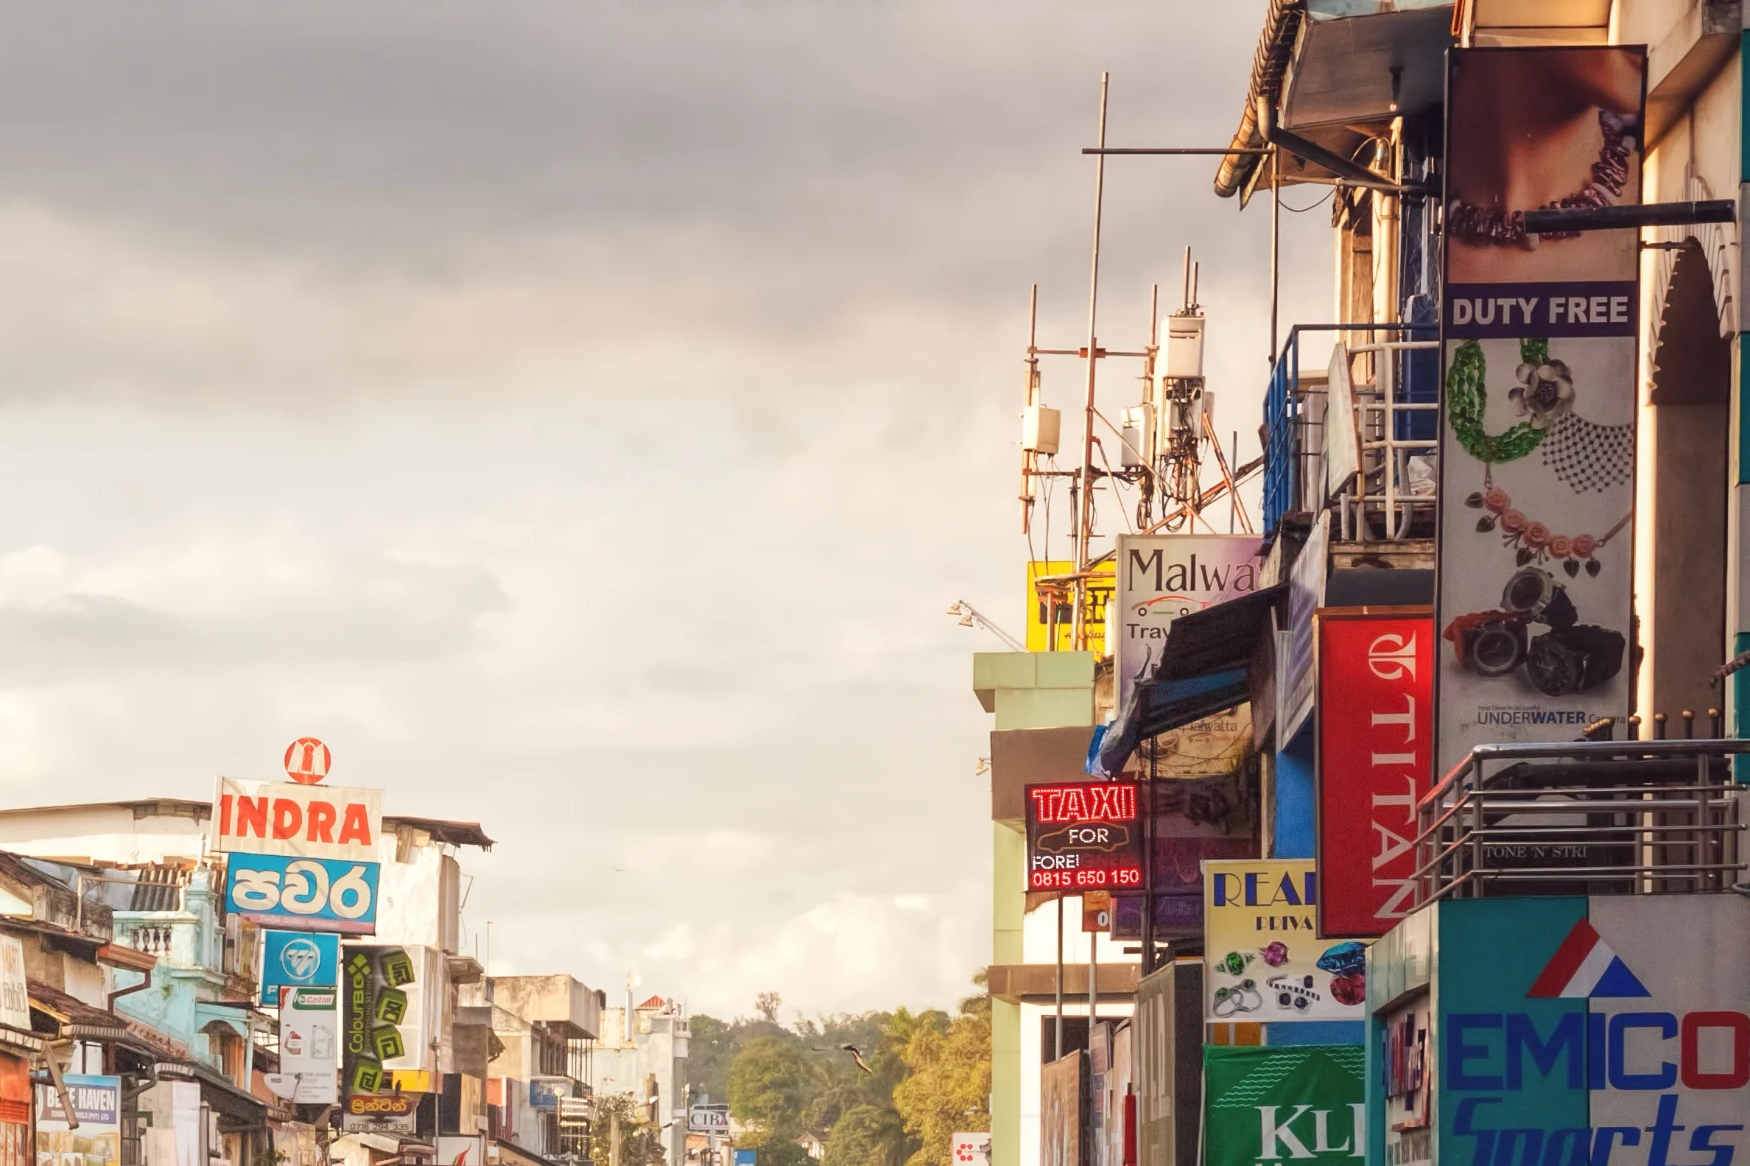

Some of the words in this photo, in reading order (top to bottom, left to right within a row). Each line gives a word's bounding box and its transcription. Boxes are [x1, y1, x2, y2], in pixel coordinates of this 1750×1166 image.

[1453, 296, 1539, 325] DUTY
[1549, 295, 1629, 324] FREE
[1128, 548, 1260, 592] Malwa
[1478, 711, 1586, 725] UNDERWATER
[1588, 713, 1626, 725] Cara
[1032, 785, 1135, 822] TAXI
[1371, 692, 1417, 919] TITAN
[219, 794, 373, 846] INDRA
[1068, 828, 1110, 844] FOR
[1483, 845, 1528, 859] TONE
[1552, 845, 1588, 859] STRI
[1032, 871, 1072, 887] 0815
[1077, 870, 1107, 886] 650
[1111, 869, 1140, 884] 150
[306, 995, 332, 1005] Castrol
[1445, 1010, 1750, 1091] EMICO
[78, 1087, 116, 1112] HAVEN
